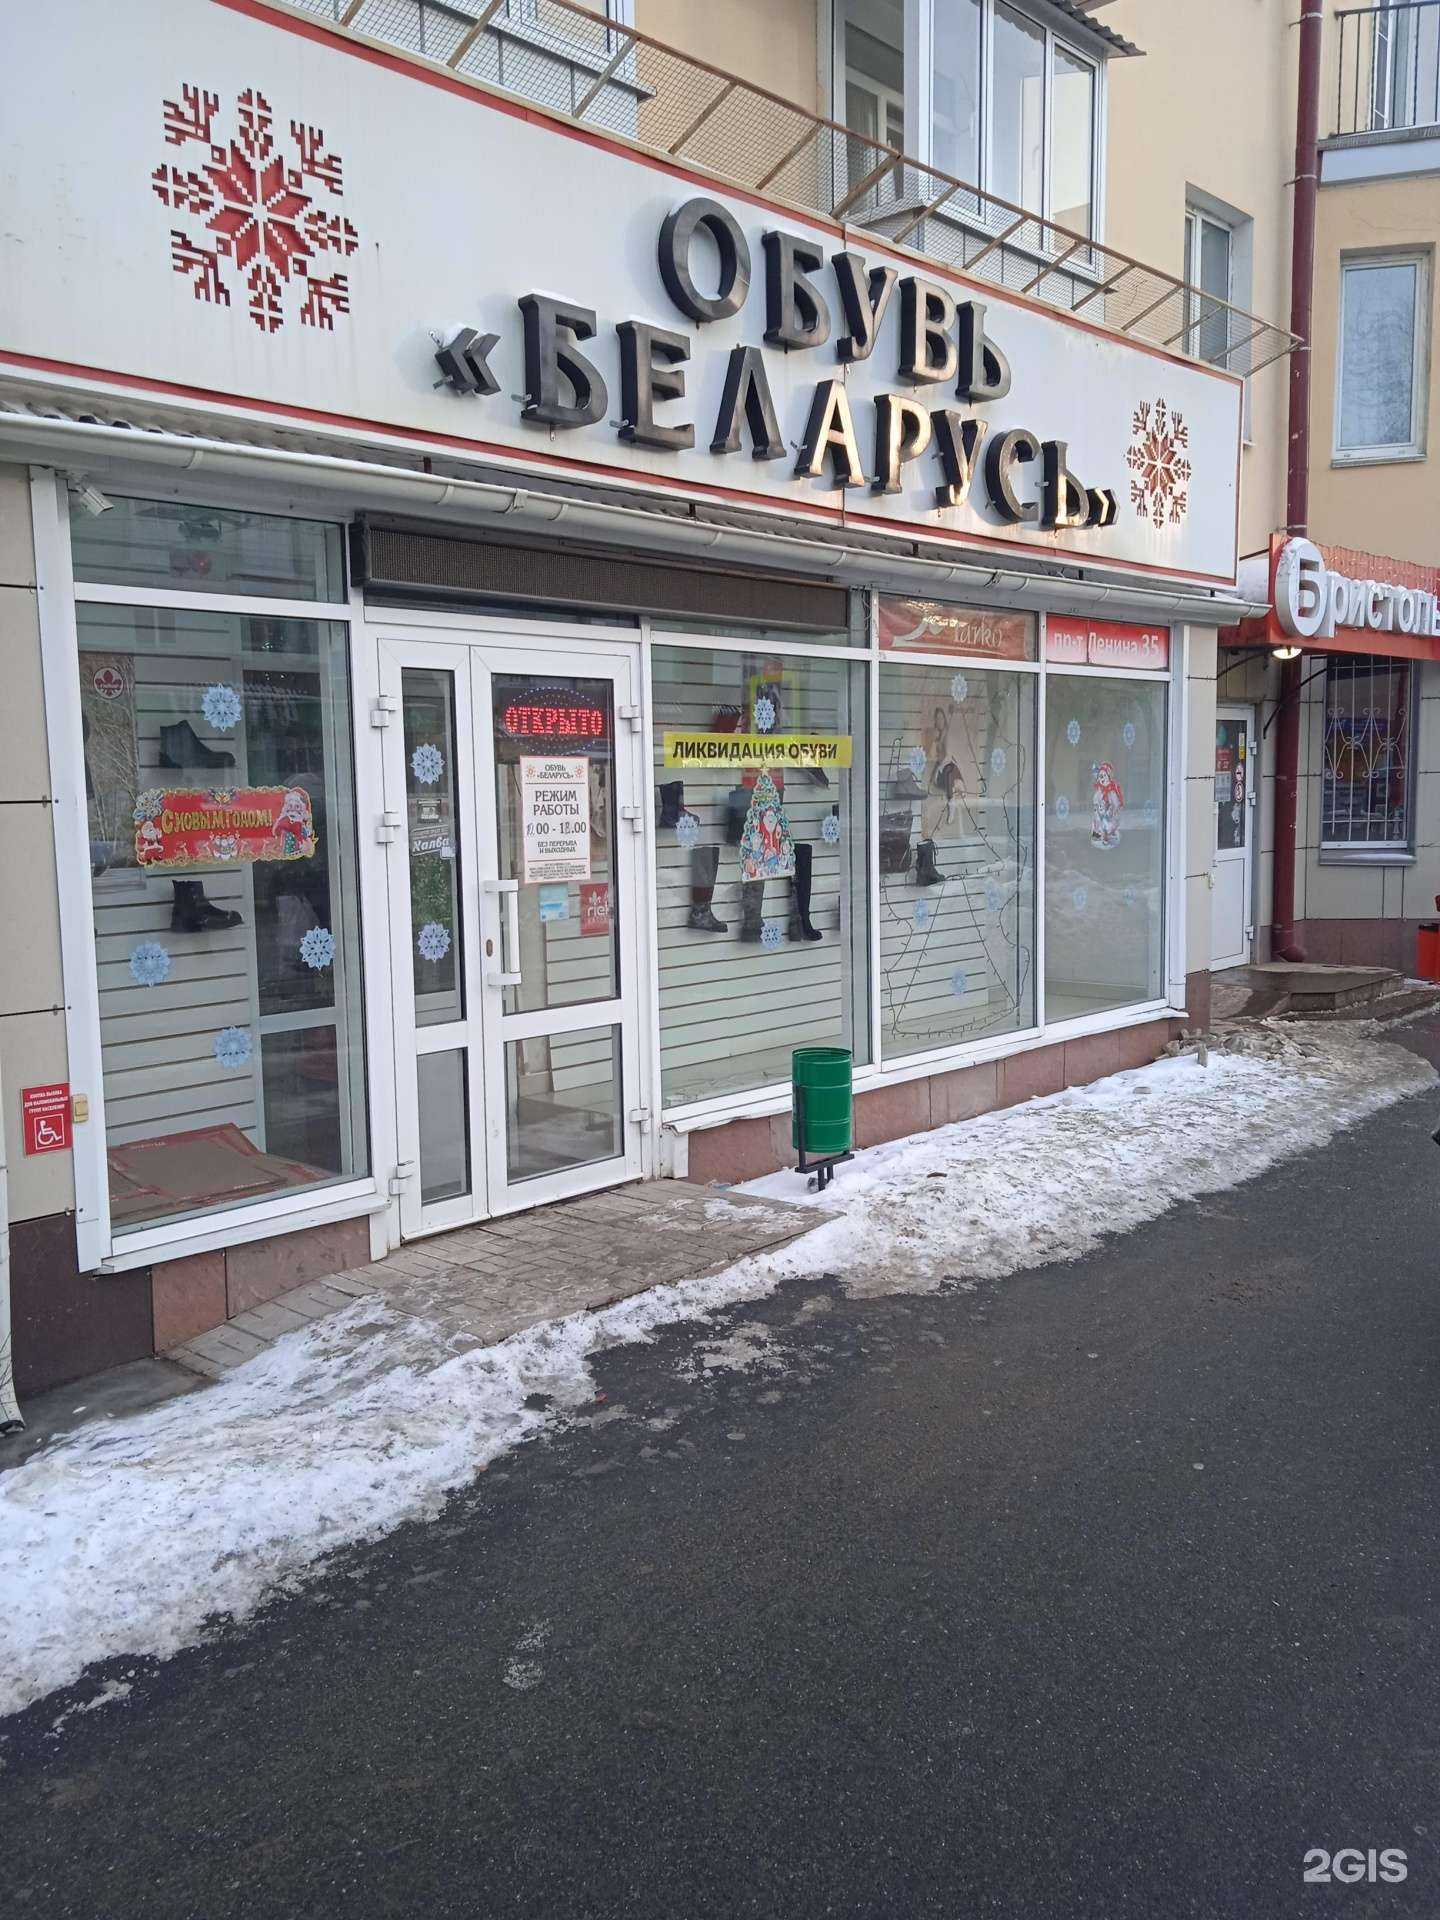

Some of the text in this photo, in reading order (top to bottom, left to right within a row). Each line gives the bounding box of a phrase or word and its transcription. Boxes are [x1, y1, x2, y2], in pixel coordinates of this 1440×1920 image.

[658, 196, 1011, 402] ОБУВЬ
[434, 292, 1120, 531] «БЕЛАРУСЬ»
[1054, 631, 1159, 657] пр-т Ленина 35
[505, 706, 603, 735] ОТКРЫТО
[672, 741, 838, 761] ЛИКВИДАЦИЯ ОБУВИ
[535, 790, 577, 802] РЕЖИМ
[533, 803, 580, 816] РАБОТЫ
